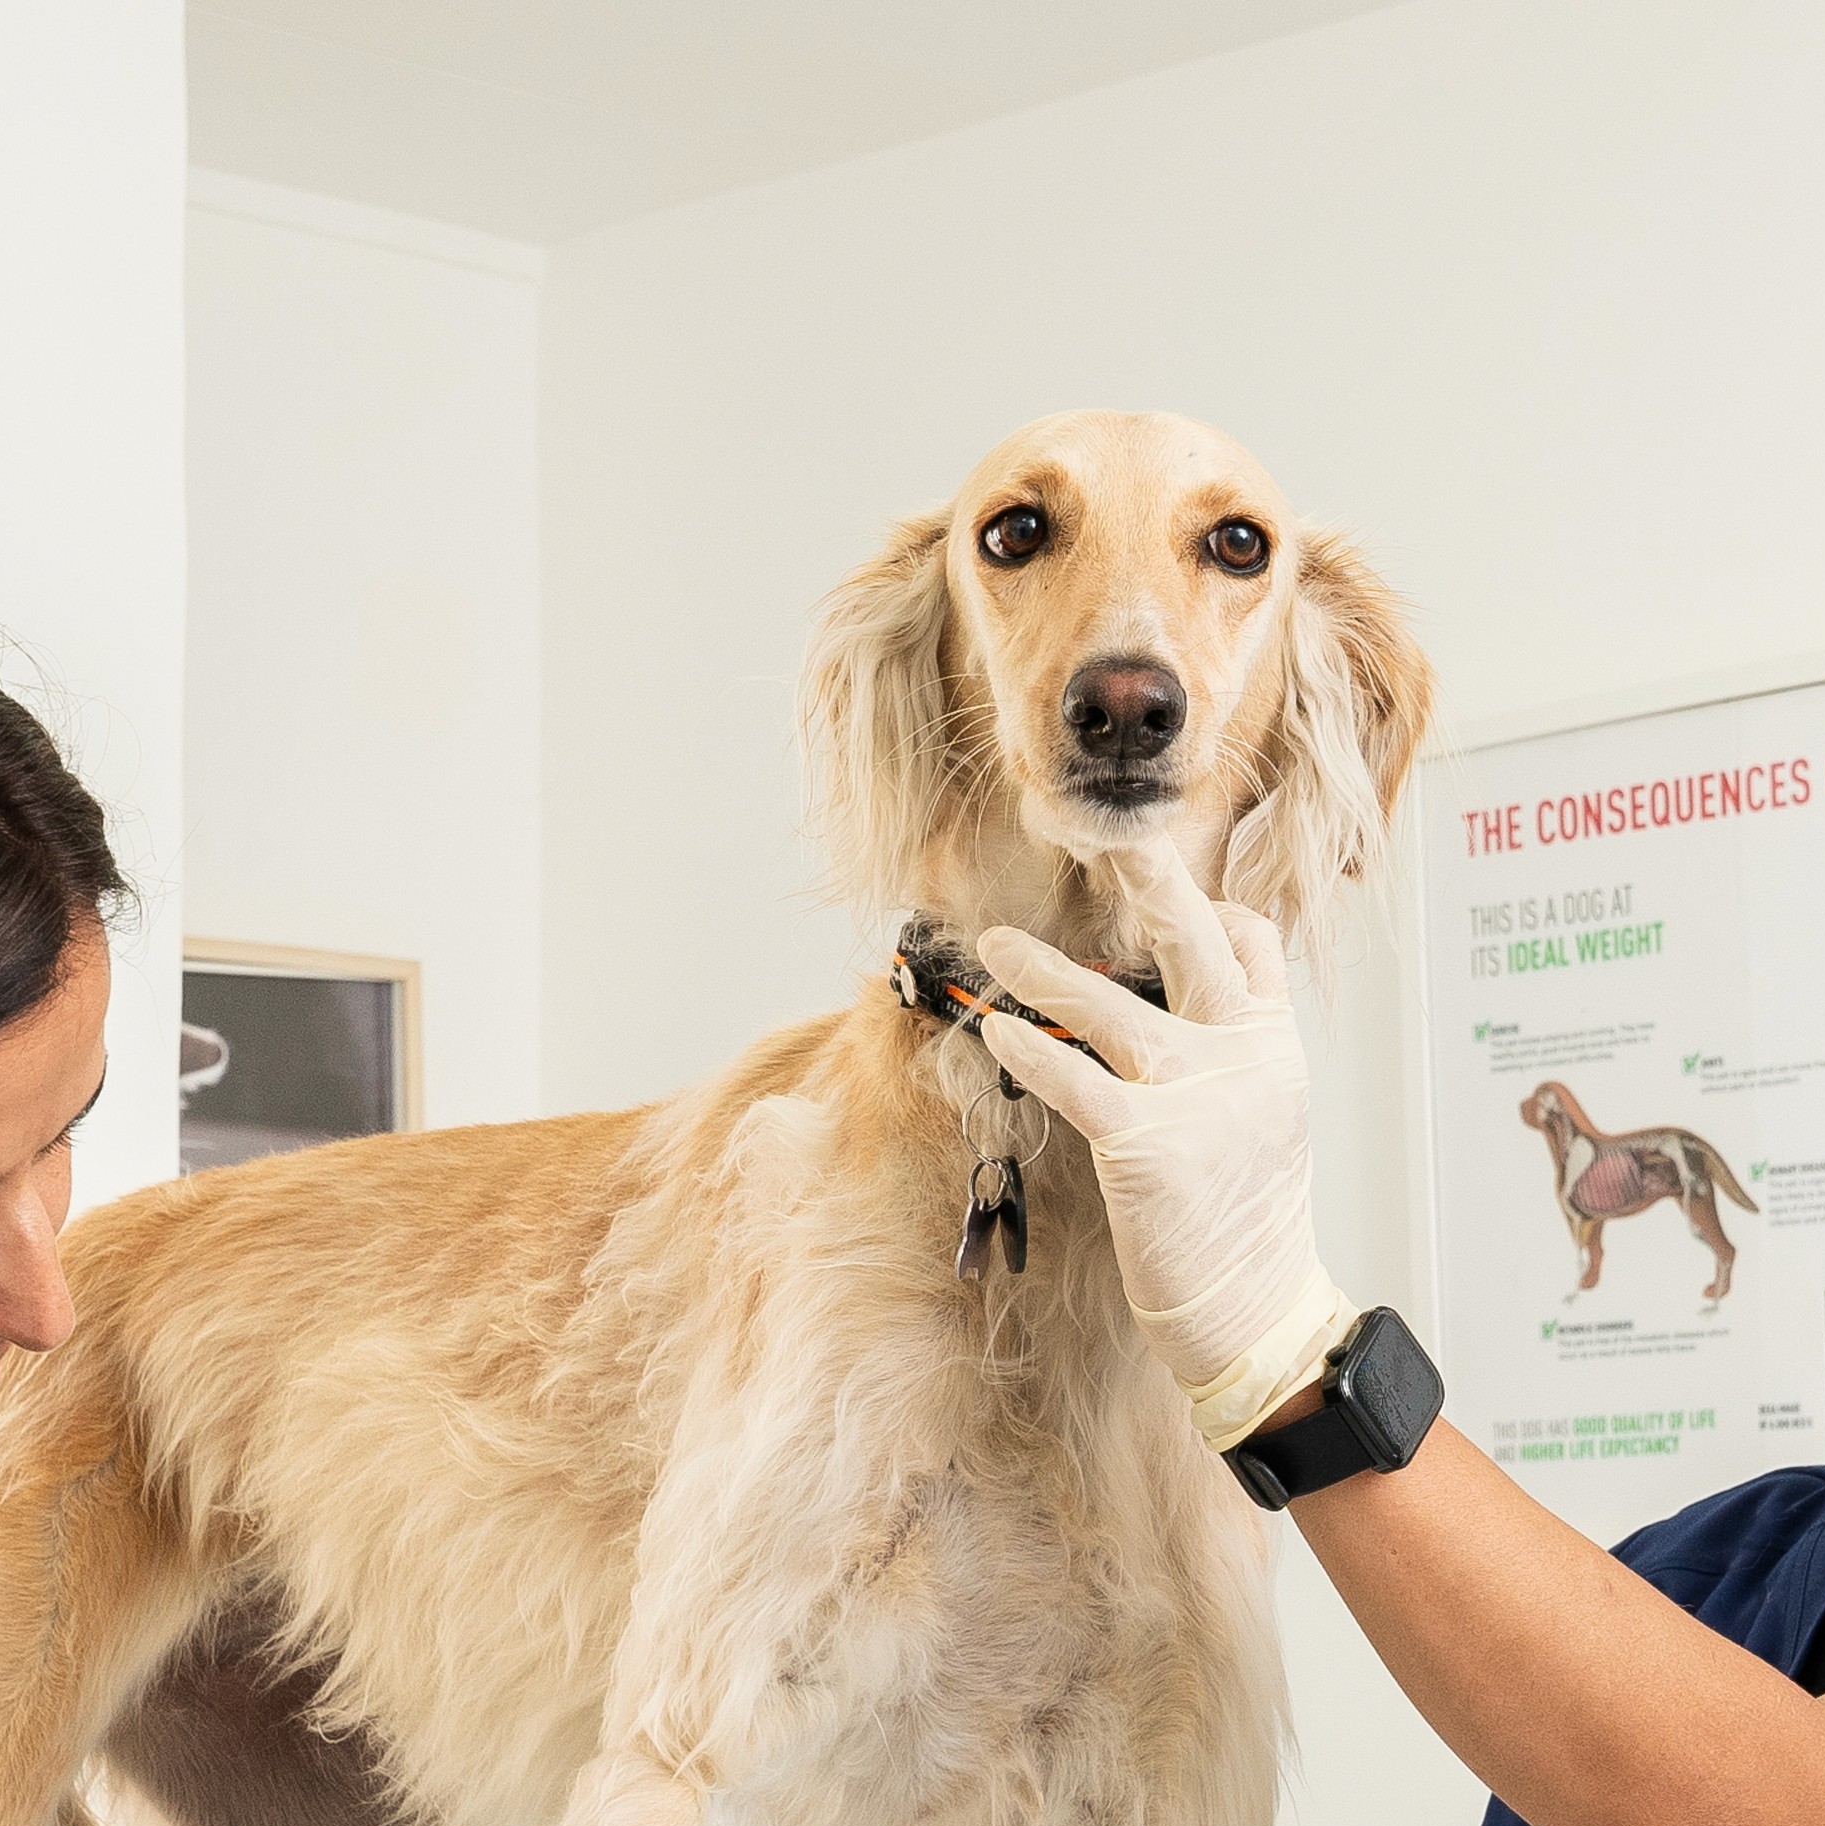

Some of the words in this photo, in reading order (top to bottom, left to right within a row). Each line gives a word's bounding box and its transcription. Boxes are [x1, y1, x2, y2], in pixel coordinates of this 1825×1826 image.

[1464, 803, 1522, 857] THE
[1536, 759, 1811, 846] CONSEQUENCES
[1470, 903, 1512, 938] THIS
[1519, 898, 1538, 931] IS
[1545, 897, 1558, 927] A
[1563, 888, 1604, 925] DOG
[1611, 884, 1632, 918] AT
[1471, 945, 1500, 978] ITS
[1507, 936, 1569, 974] IDEAL
[1576, 921, 1664, 964] WEIGHT
[1572, 1415, 1607, 1435] GOOD
[1611, 1412, 1664, 1434] QUALITY
[1668, 1410, 1685, 1430] OF
[1689, 1408, 1716, 1429] LIFE
[1520, 1441, 1565, 1462] HIGHER
[1569, 1439, 1595, 1459] LIFE
[1599, 1436, 1680, 1457] EXPECTANCY
